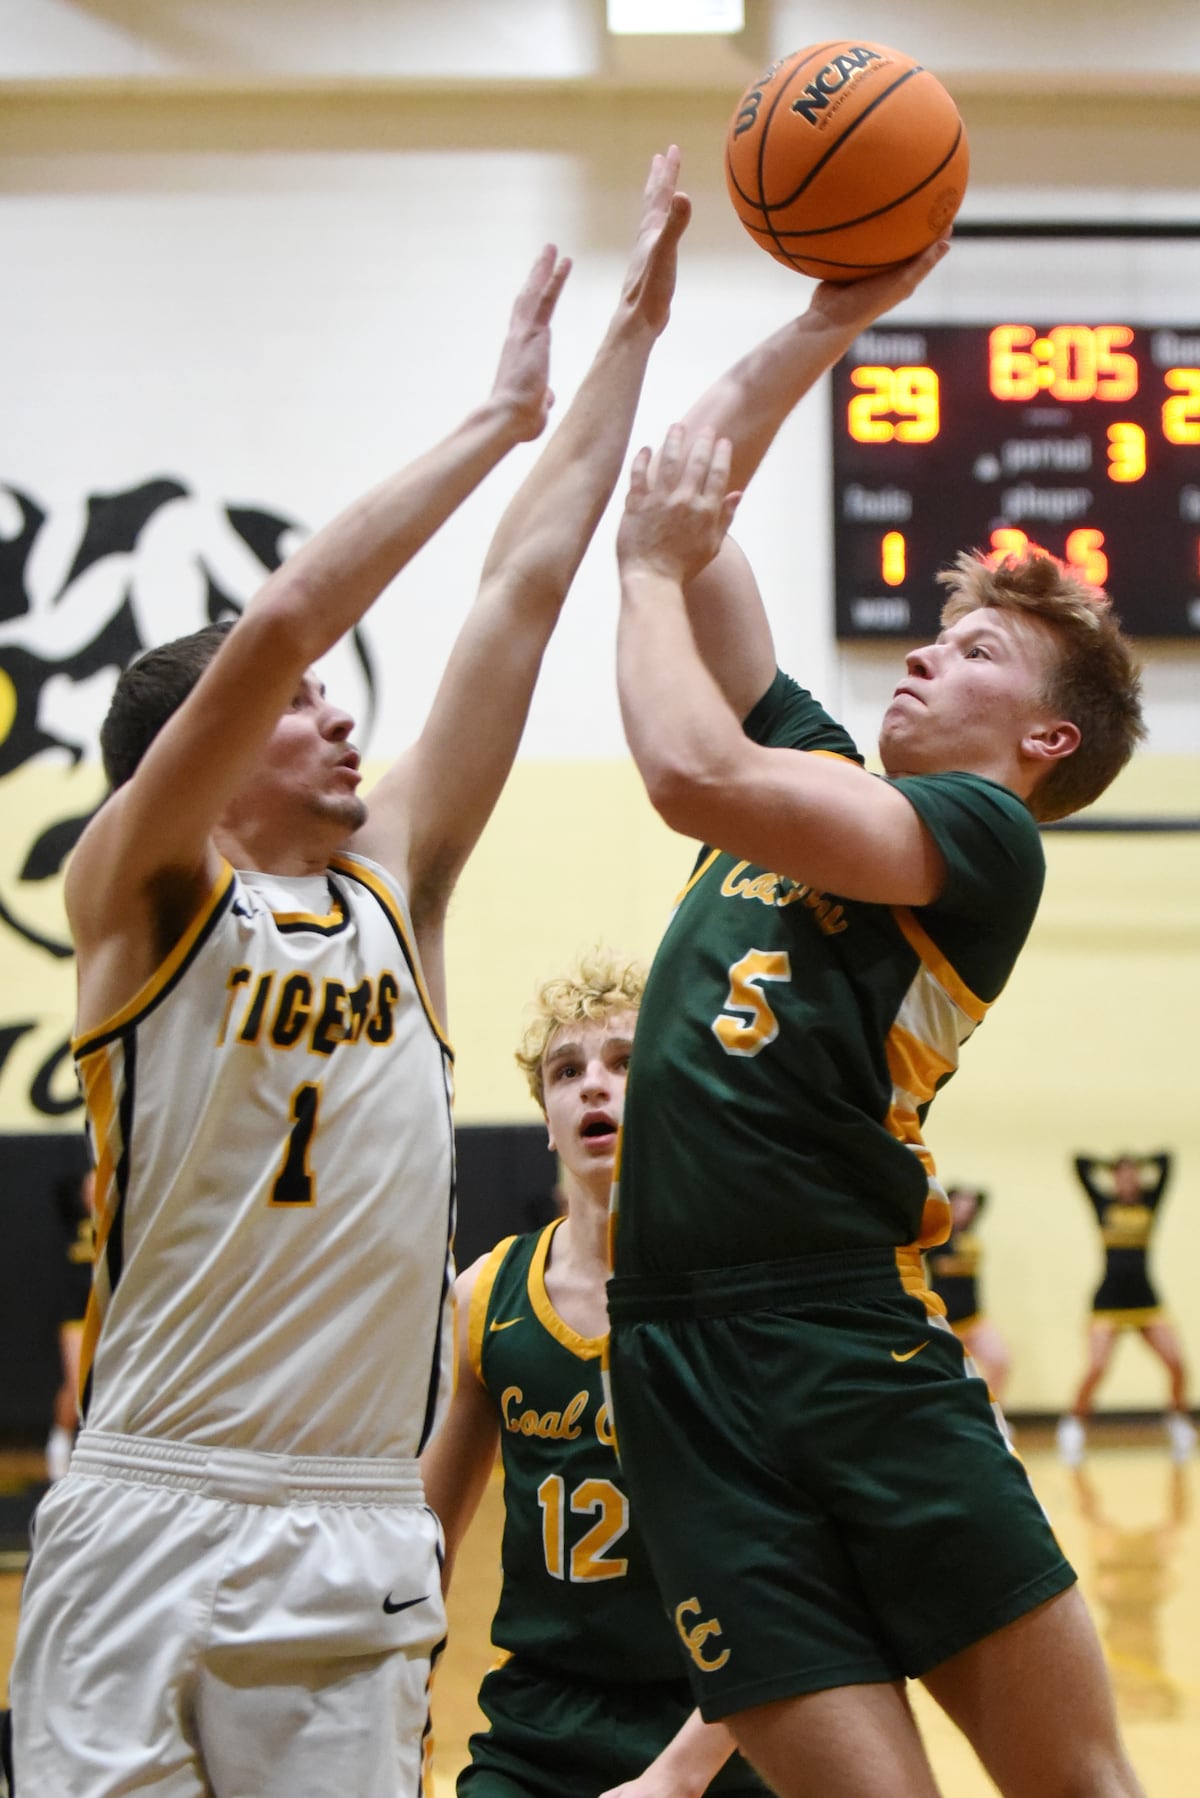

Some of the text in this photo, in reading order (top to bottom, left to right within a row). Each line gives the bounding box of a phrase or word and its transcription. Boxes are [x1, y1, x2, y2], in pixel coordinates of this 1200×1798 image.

[791, 46, 884, 128] NCAA
[989, 325, 1139, 401] 6:05
[848, 366, 940, 443] 29
[1107, 422, 1146, 482] 3
[882, 531, 906, 586] 1
[215, 963, 399, 1058] TIGERS
[711, 947, 791, 1058] 5
[267, 1075, 323, 1208] 1
[501, 1386, 589, 1439] Coal
[537, 1473, 630, 1582] 12
